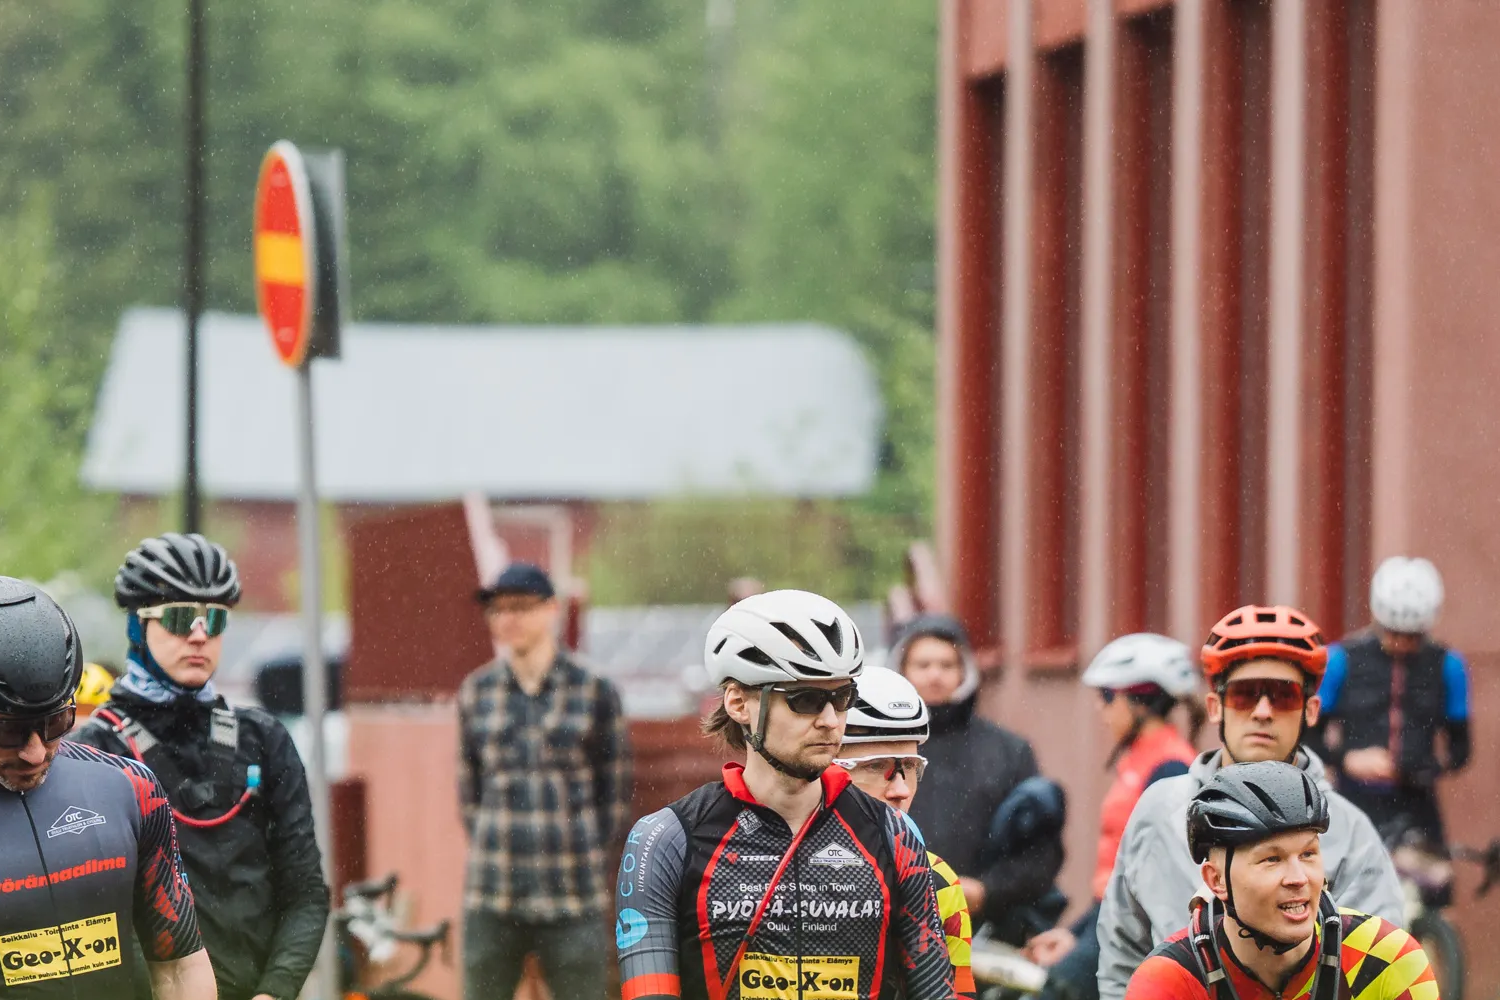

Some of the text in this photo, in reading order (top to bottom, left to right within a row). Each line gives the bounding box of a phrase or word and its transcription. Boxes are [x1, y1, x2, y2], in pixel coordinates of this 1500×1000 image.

[65, 811, 83, 823] OTC
[638, 822, 665, 892] LIIKUNTAKESKUS
[740, 854, 781, 862] TREK
[827, 849, 843, 857] OTC
[739, 883, 763, 892] Best
[765, 883, 788, 892] Bke
[820, 882, 828, 892] in
[829, 882, 856, 892] Town
[767, 922, 790, 931] Oulu
[802, 921, 837, 931] Finland
[2, 935, 118, 971] Geo-X-on
[741, 969, 855, 992] Geo-X-on
